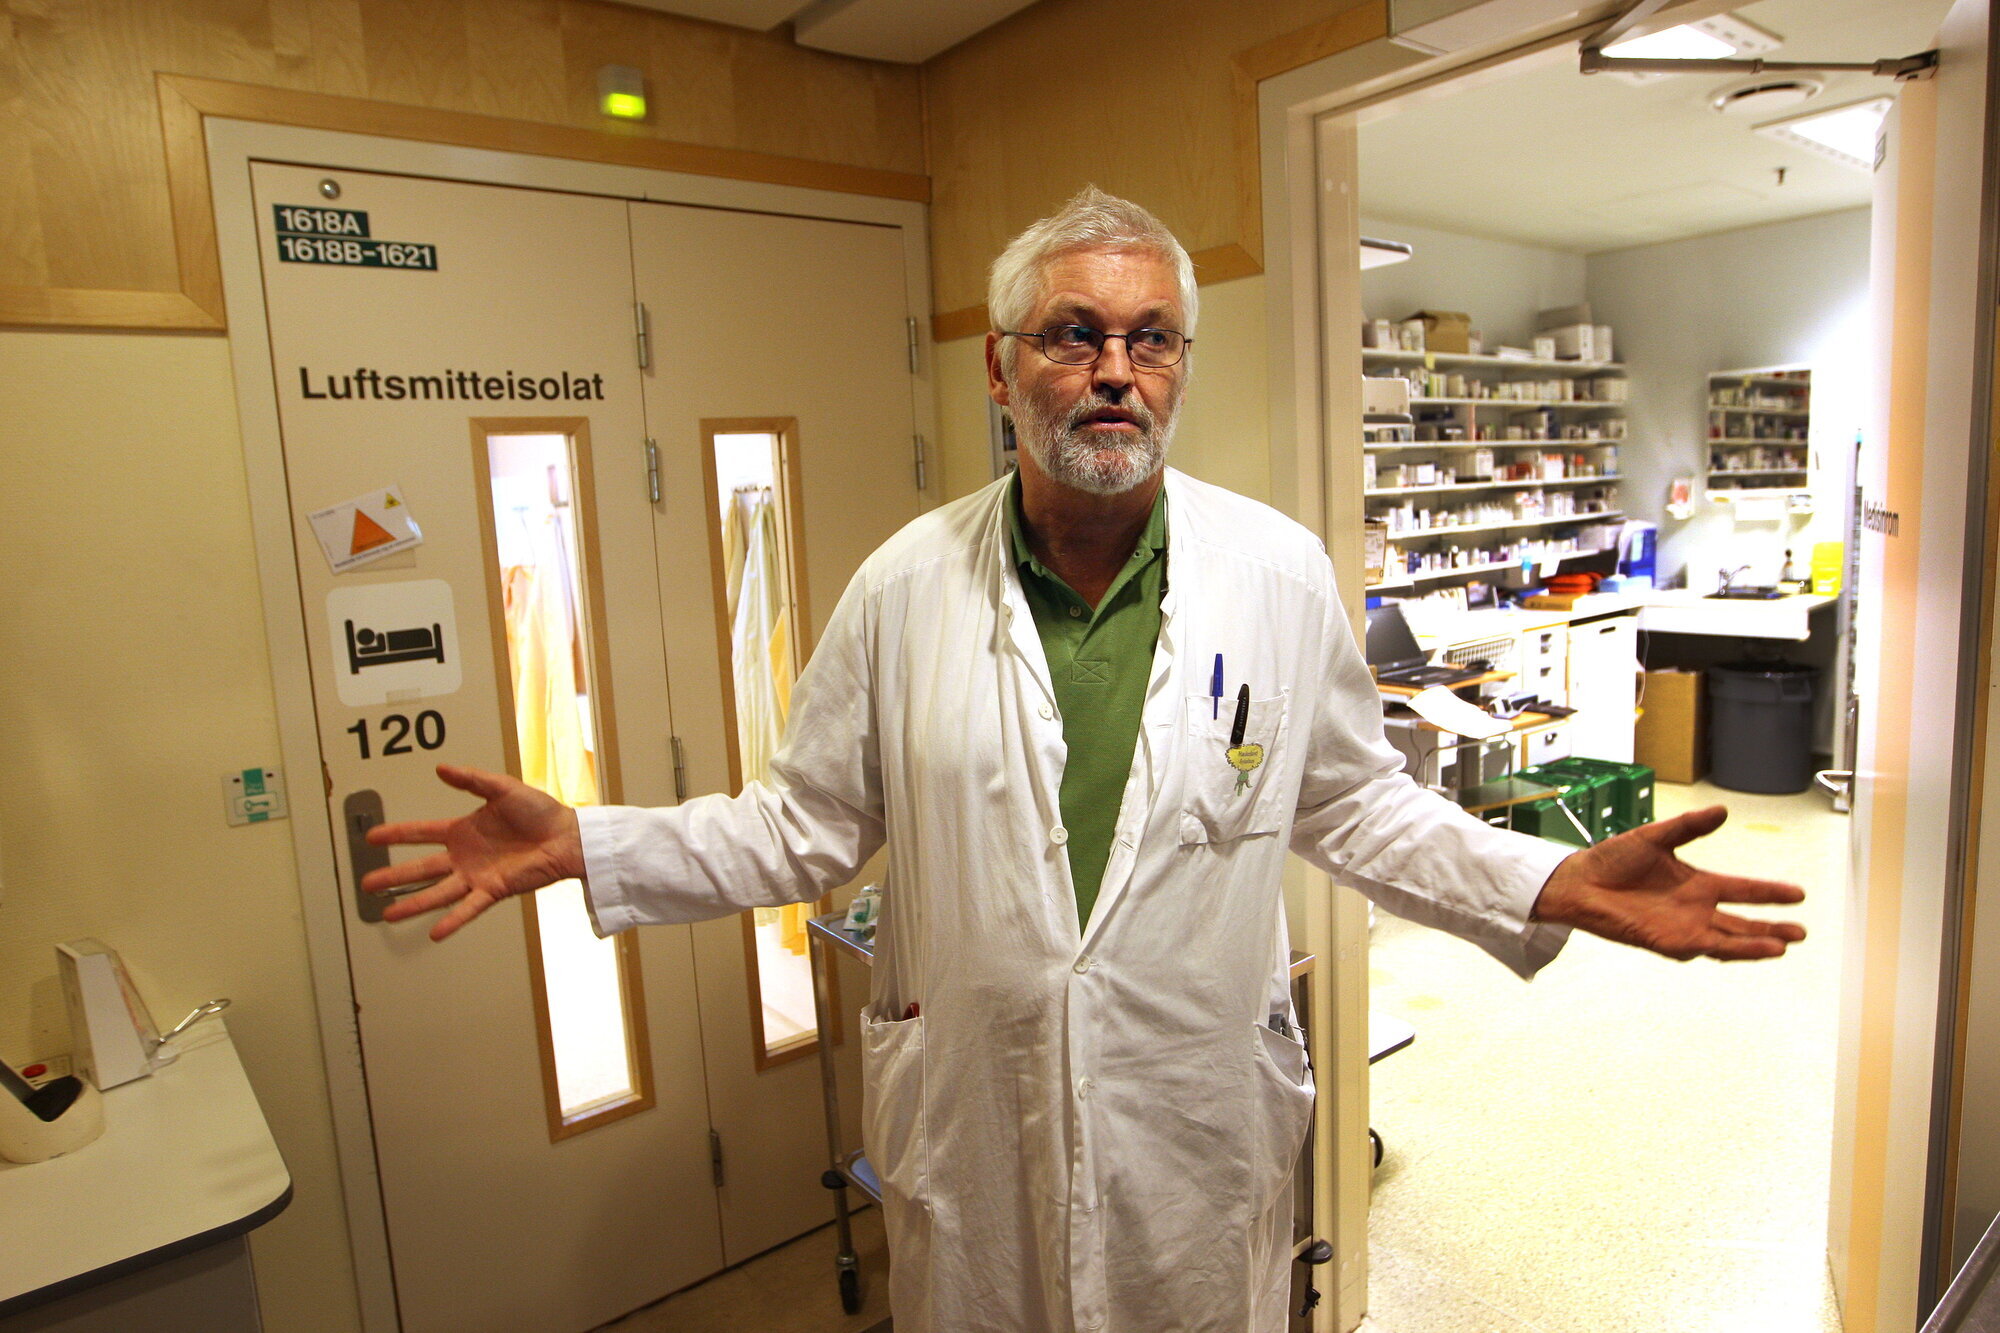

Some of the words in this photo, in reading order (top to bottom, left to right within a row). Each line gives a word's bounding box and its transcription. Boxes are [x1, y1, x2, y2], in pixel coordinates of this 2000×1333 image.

[280, 209, 361, 235] 1618A
[282, 239, 433, 268] 1618B-1621
[300, 367, 605, 401] Luftsmitteisolat
[347, 709, 446, 759] 120
